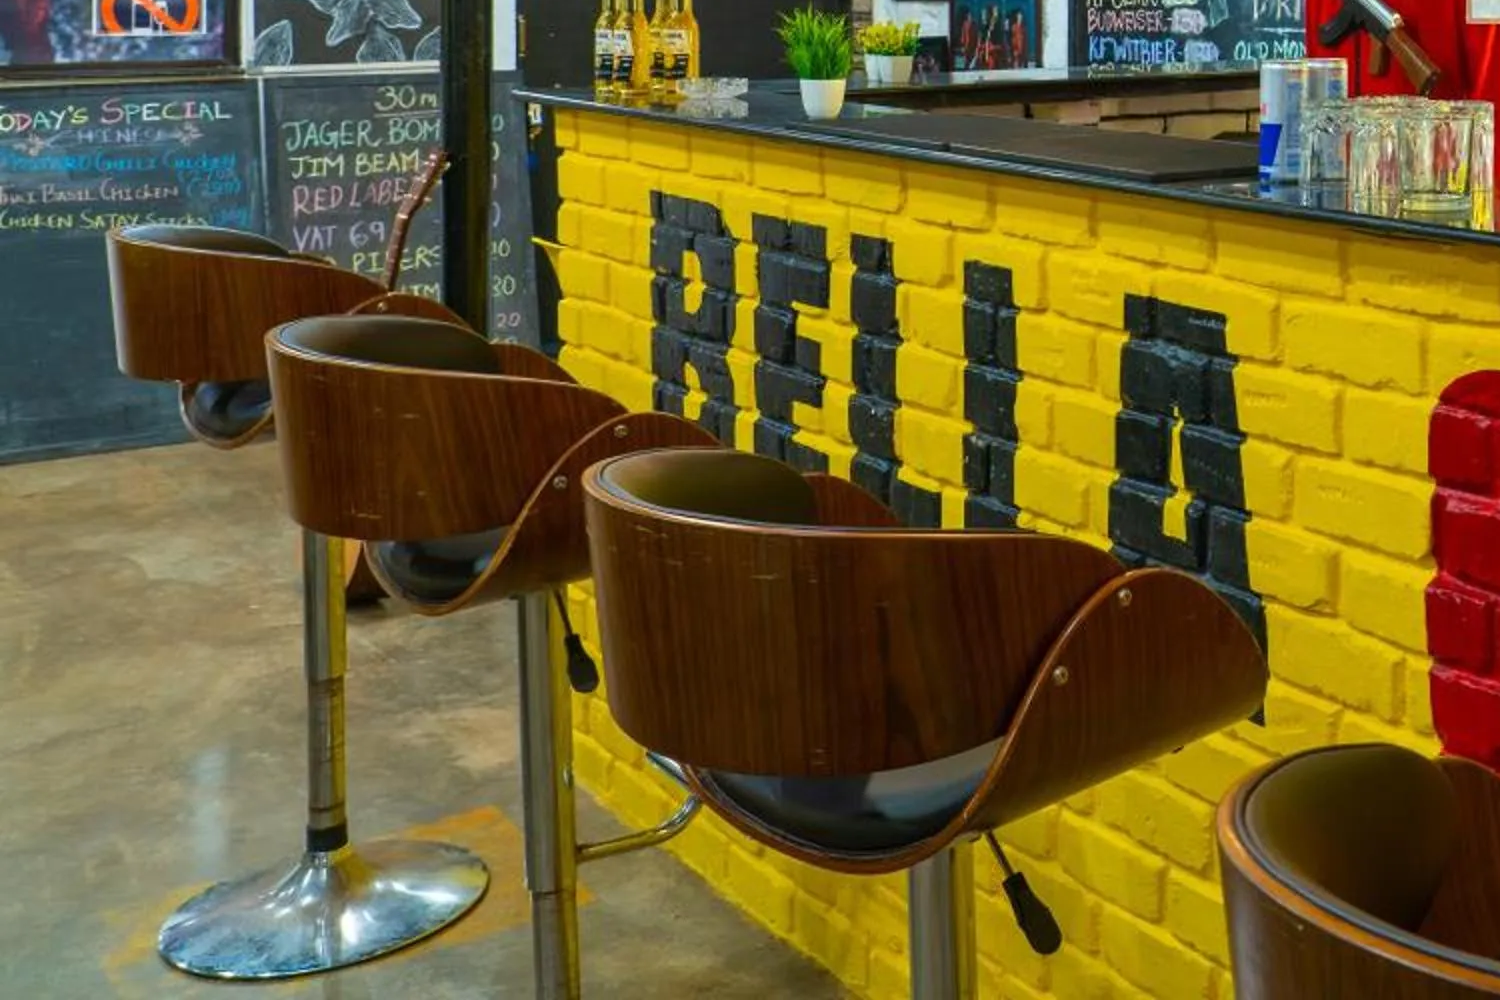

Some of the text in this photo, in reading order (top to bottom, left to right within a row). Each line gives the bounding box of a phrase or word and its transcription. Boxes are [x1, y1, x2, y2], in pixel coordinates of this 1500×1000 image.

[101, 98, 233, 125] SPECIAL
[281, 117, 441, 151] JAGER BOM
[288, 149, 420, 180] JIM BEAM
[293, 178, 410, 219] RED LABE
[292, 220, 387, 252] VAT 69
[352, 244, 442, 275] PIERS
[650, 189, 1267, 727] BELLA
